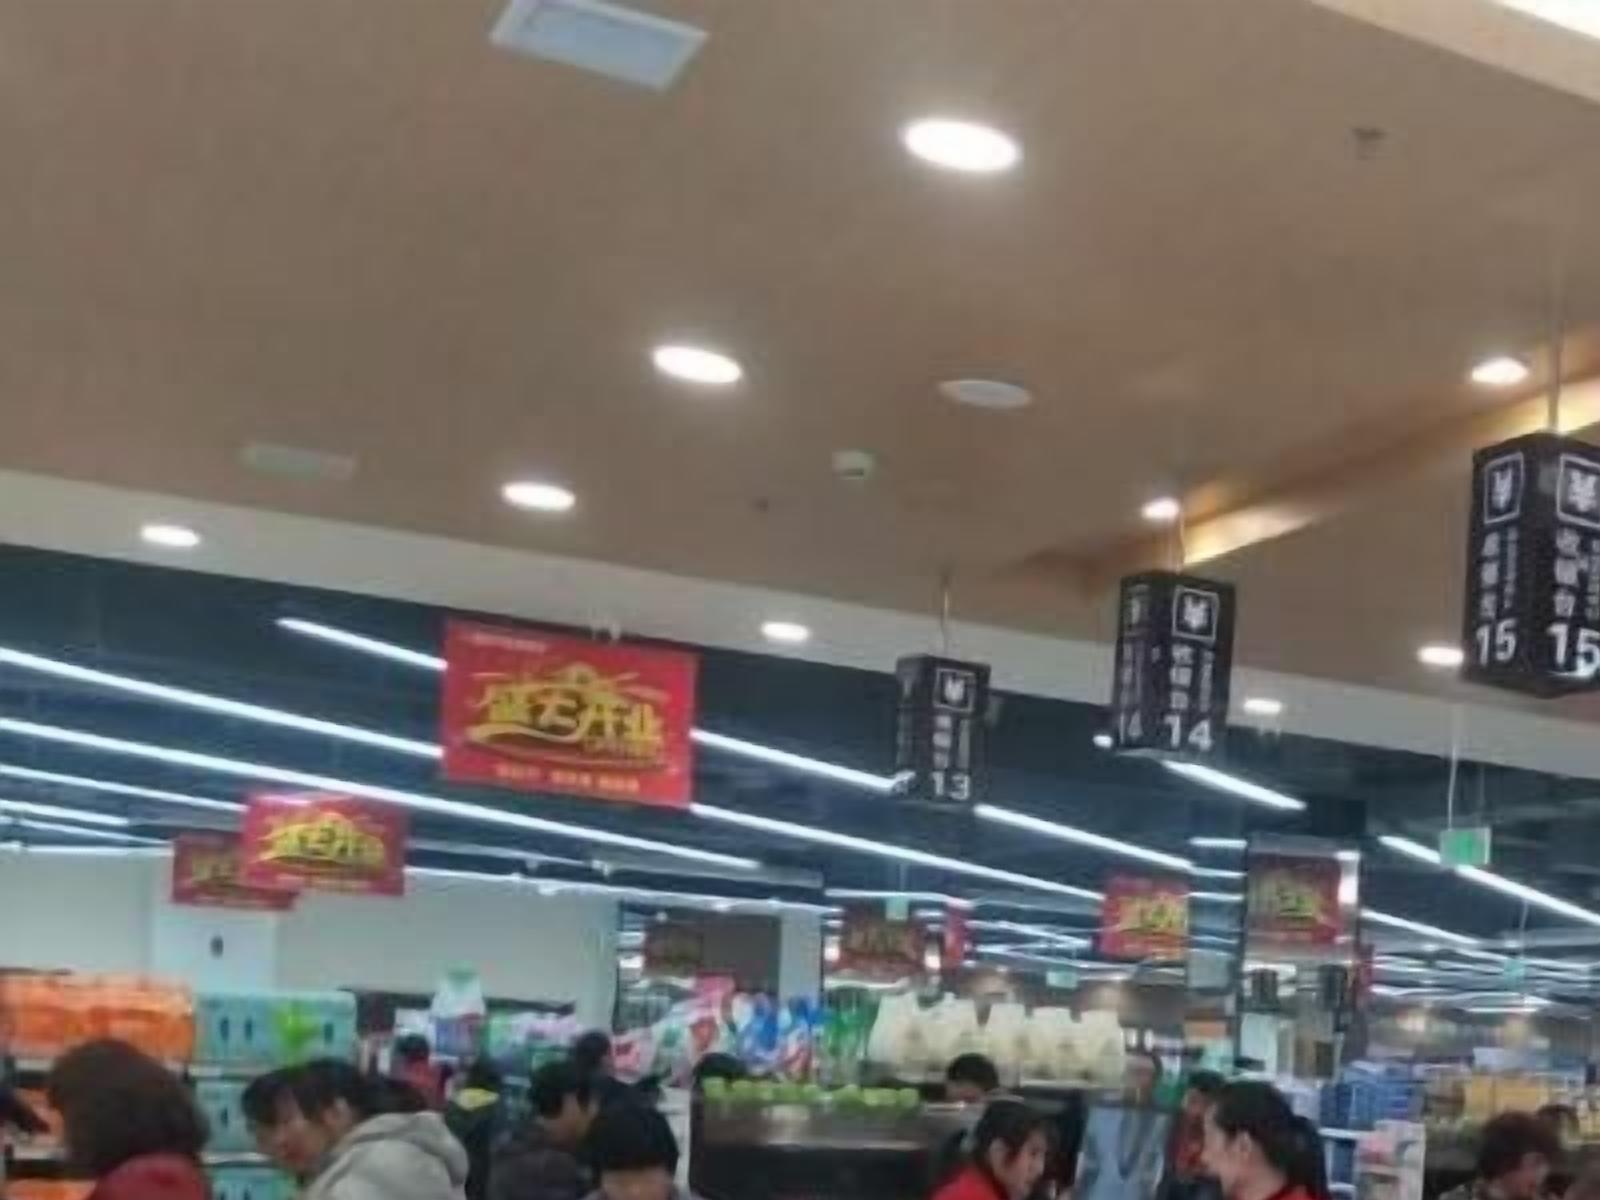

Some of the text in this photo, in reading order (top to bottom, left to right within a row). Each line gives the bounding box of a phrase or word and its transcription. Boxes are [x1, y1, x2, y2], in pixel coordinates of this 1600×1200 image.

[1476, 618, 1517, 667] 15
[1165, 714, 1213, 751] 14
[932, 770, 971, 801] 13
